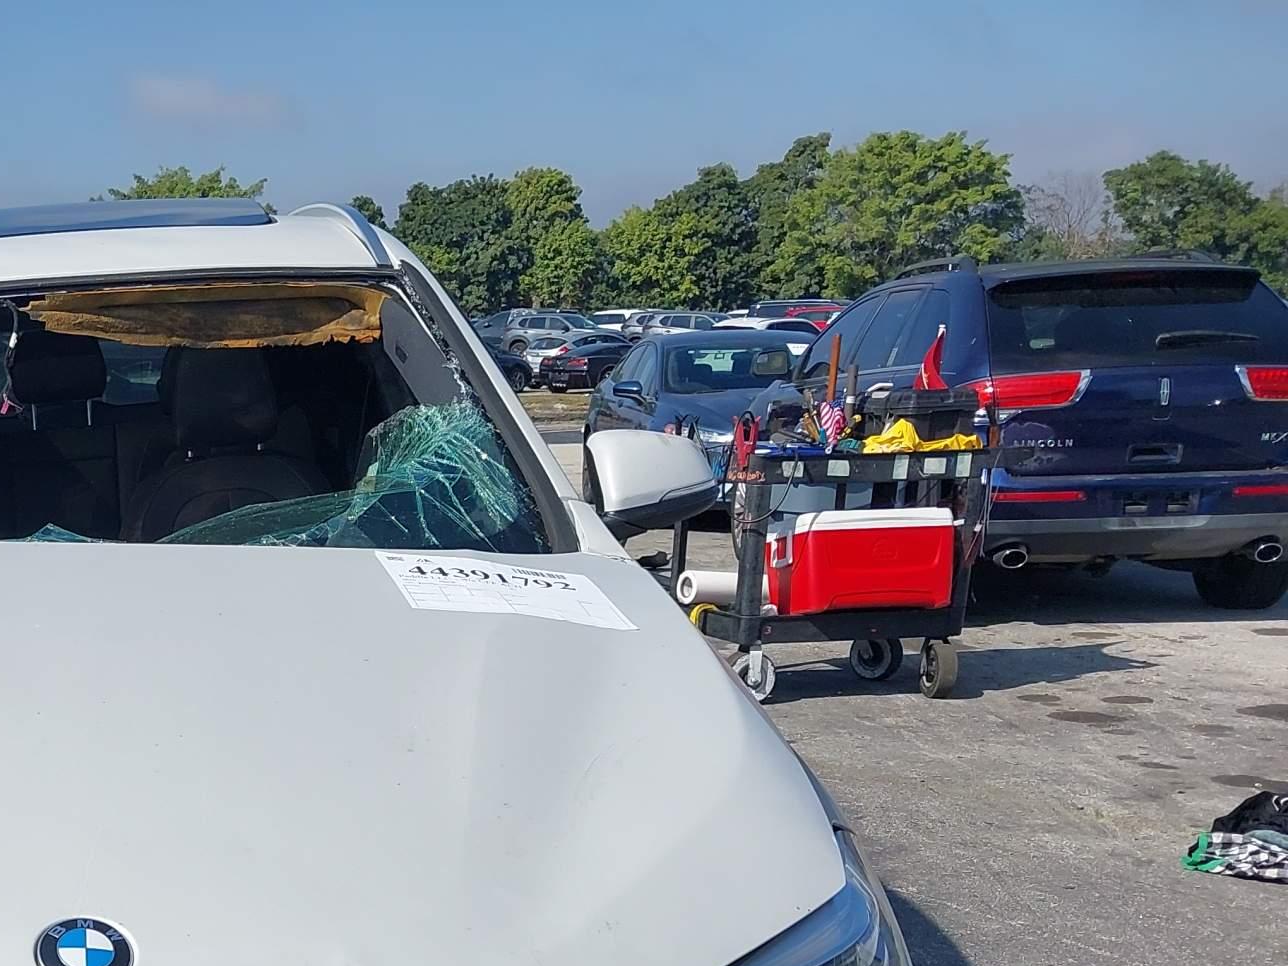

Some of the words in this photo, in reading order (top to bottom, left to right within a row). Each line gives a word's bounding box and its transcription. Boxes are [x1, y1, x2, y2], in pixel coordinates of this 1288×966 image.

[1013, 438, 1074, 448] LINCOLN
[409, 566, 576, 591] 44391792
[47, 919, 124, 941] BMW
